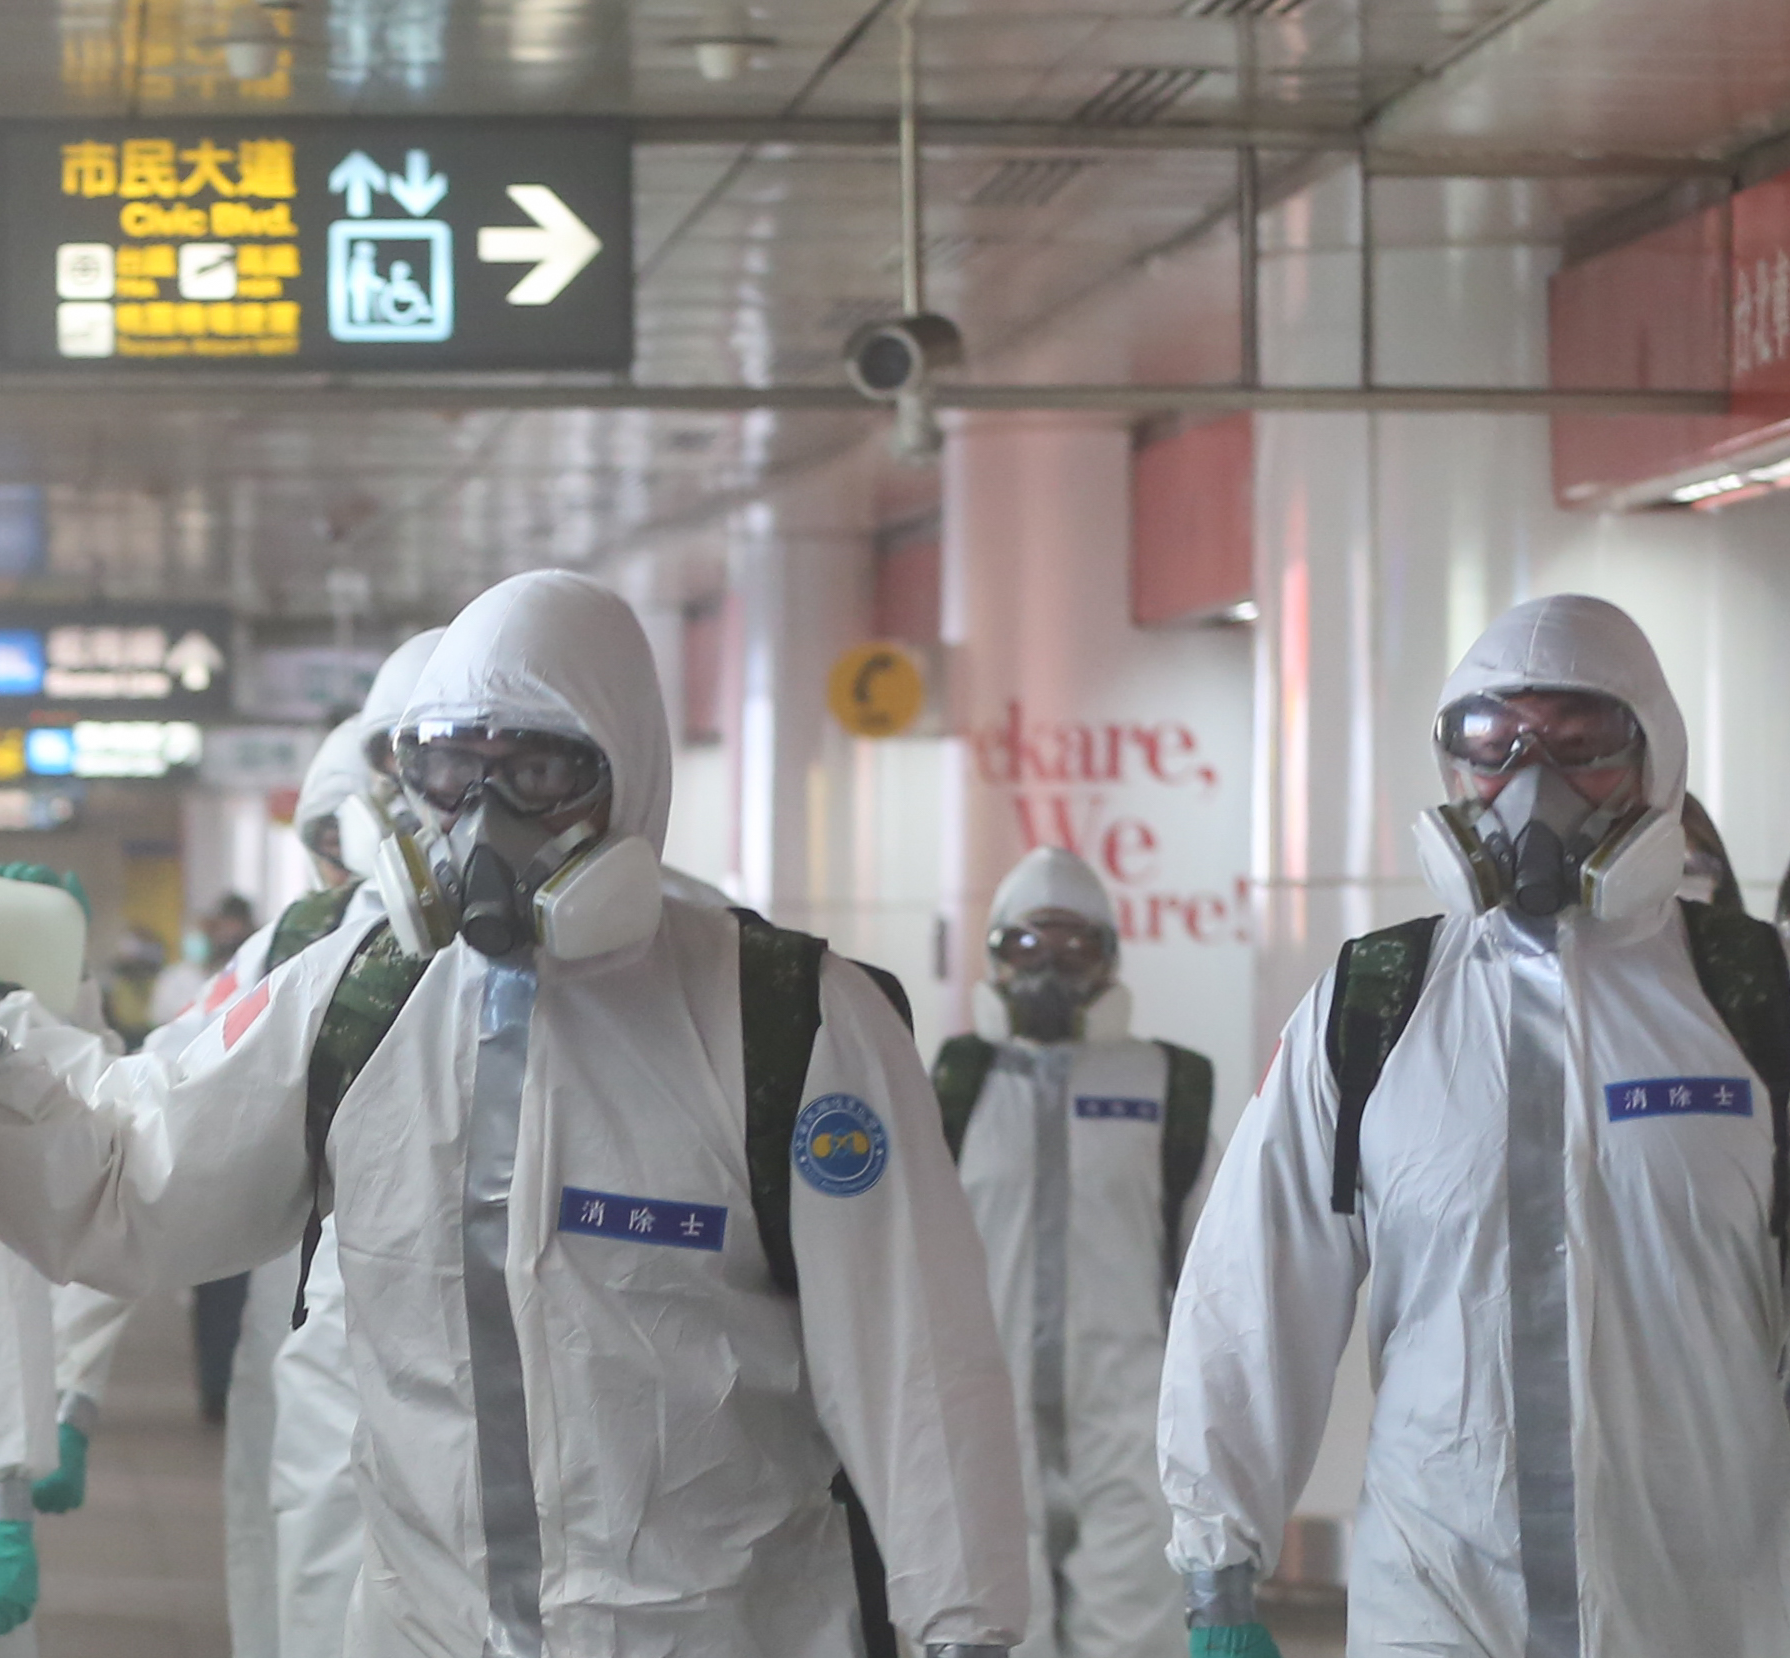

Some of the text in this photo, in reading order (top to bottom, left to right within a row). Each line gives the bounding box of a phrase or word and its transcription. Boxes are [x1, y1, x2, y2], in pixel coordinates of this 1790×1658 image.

[60, 138, 298, 198] 市民大道
[1623, 1083, 1735, 1111] 消除士
[579, 1199, 705, 1237] 消除士
